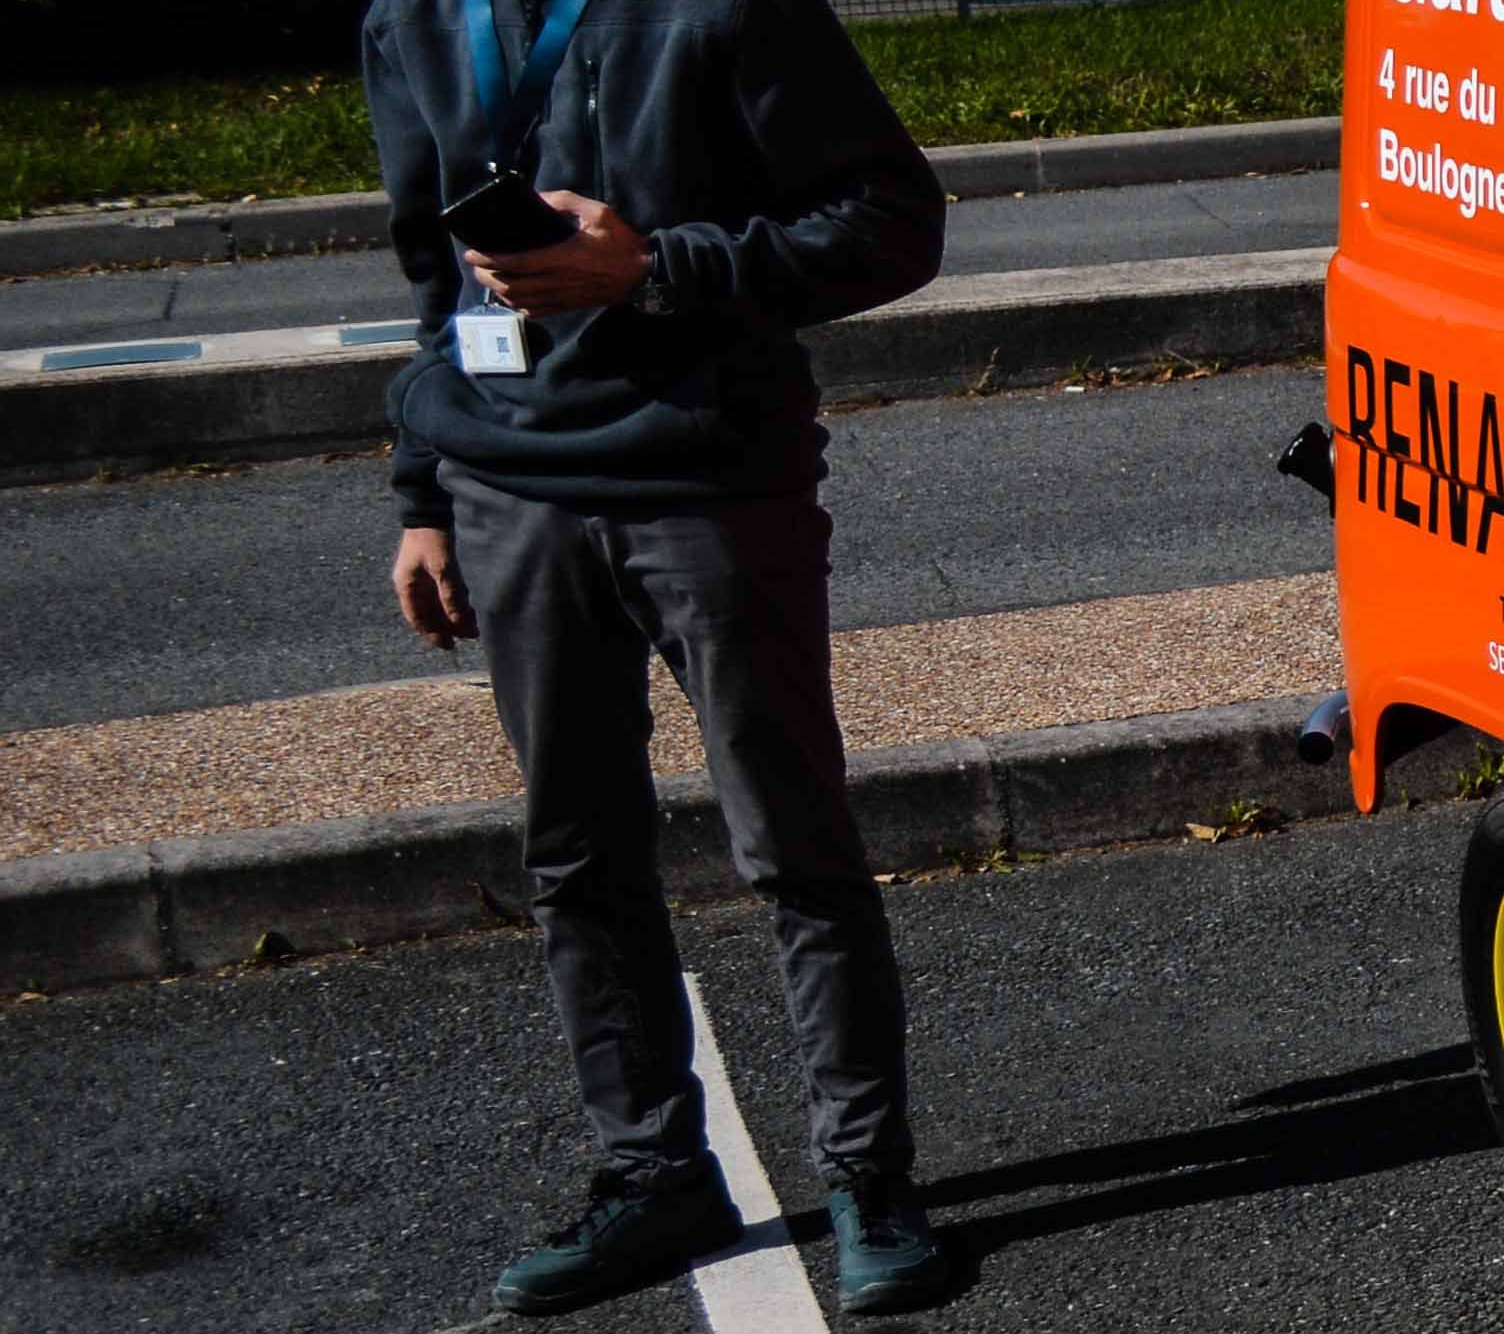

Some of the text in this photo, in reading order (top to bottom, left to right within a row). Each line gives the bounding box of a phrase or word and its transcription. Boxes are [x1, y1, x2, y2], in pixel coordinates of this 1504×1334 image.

[1379, 48, 1395, 100] 4
[1404, 63, 1450, 113] rue
[1459, 68, 1495, 125] du
